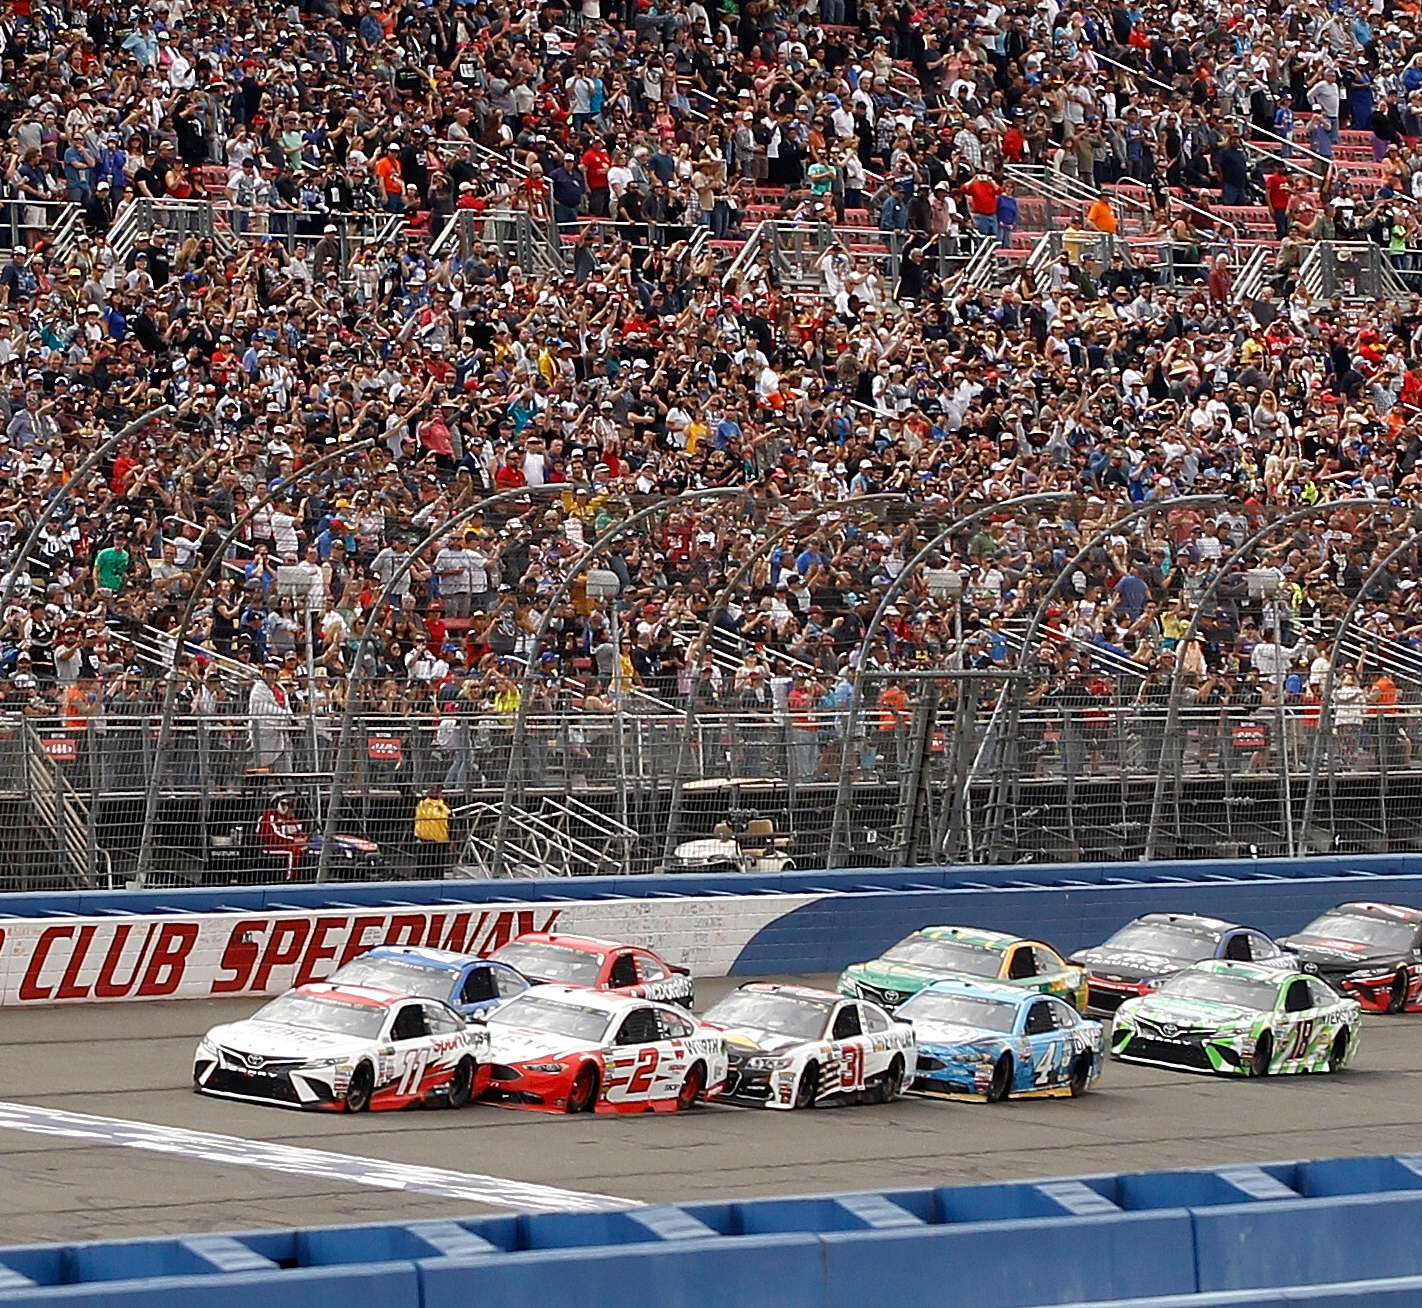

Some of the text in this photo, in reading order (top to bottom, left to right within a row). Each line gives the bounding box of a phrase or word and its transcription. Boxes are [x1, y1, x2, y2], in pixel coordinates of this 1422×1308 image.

[18, 923, 199, 1000] CLUB
[1289, 1017, 1312, 1061] 18
[396, 1048, 430, 1096] 11
[626, 1047, 659, 1094] 2
[840, 1043, 865, 1093] 31
[1035, 1042, 1056, 1085] 4
